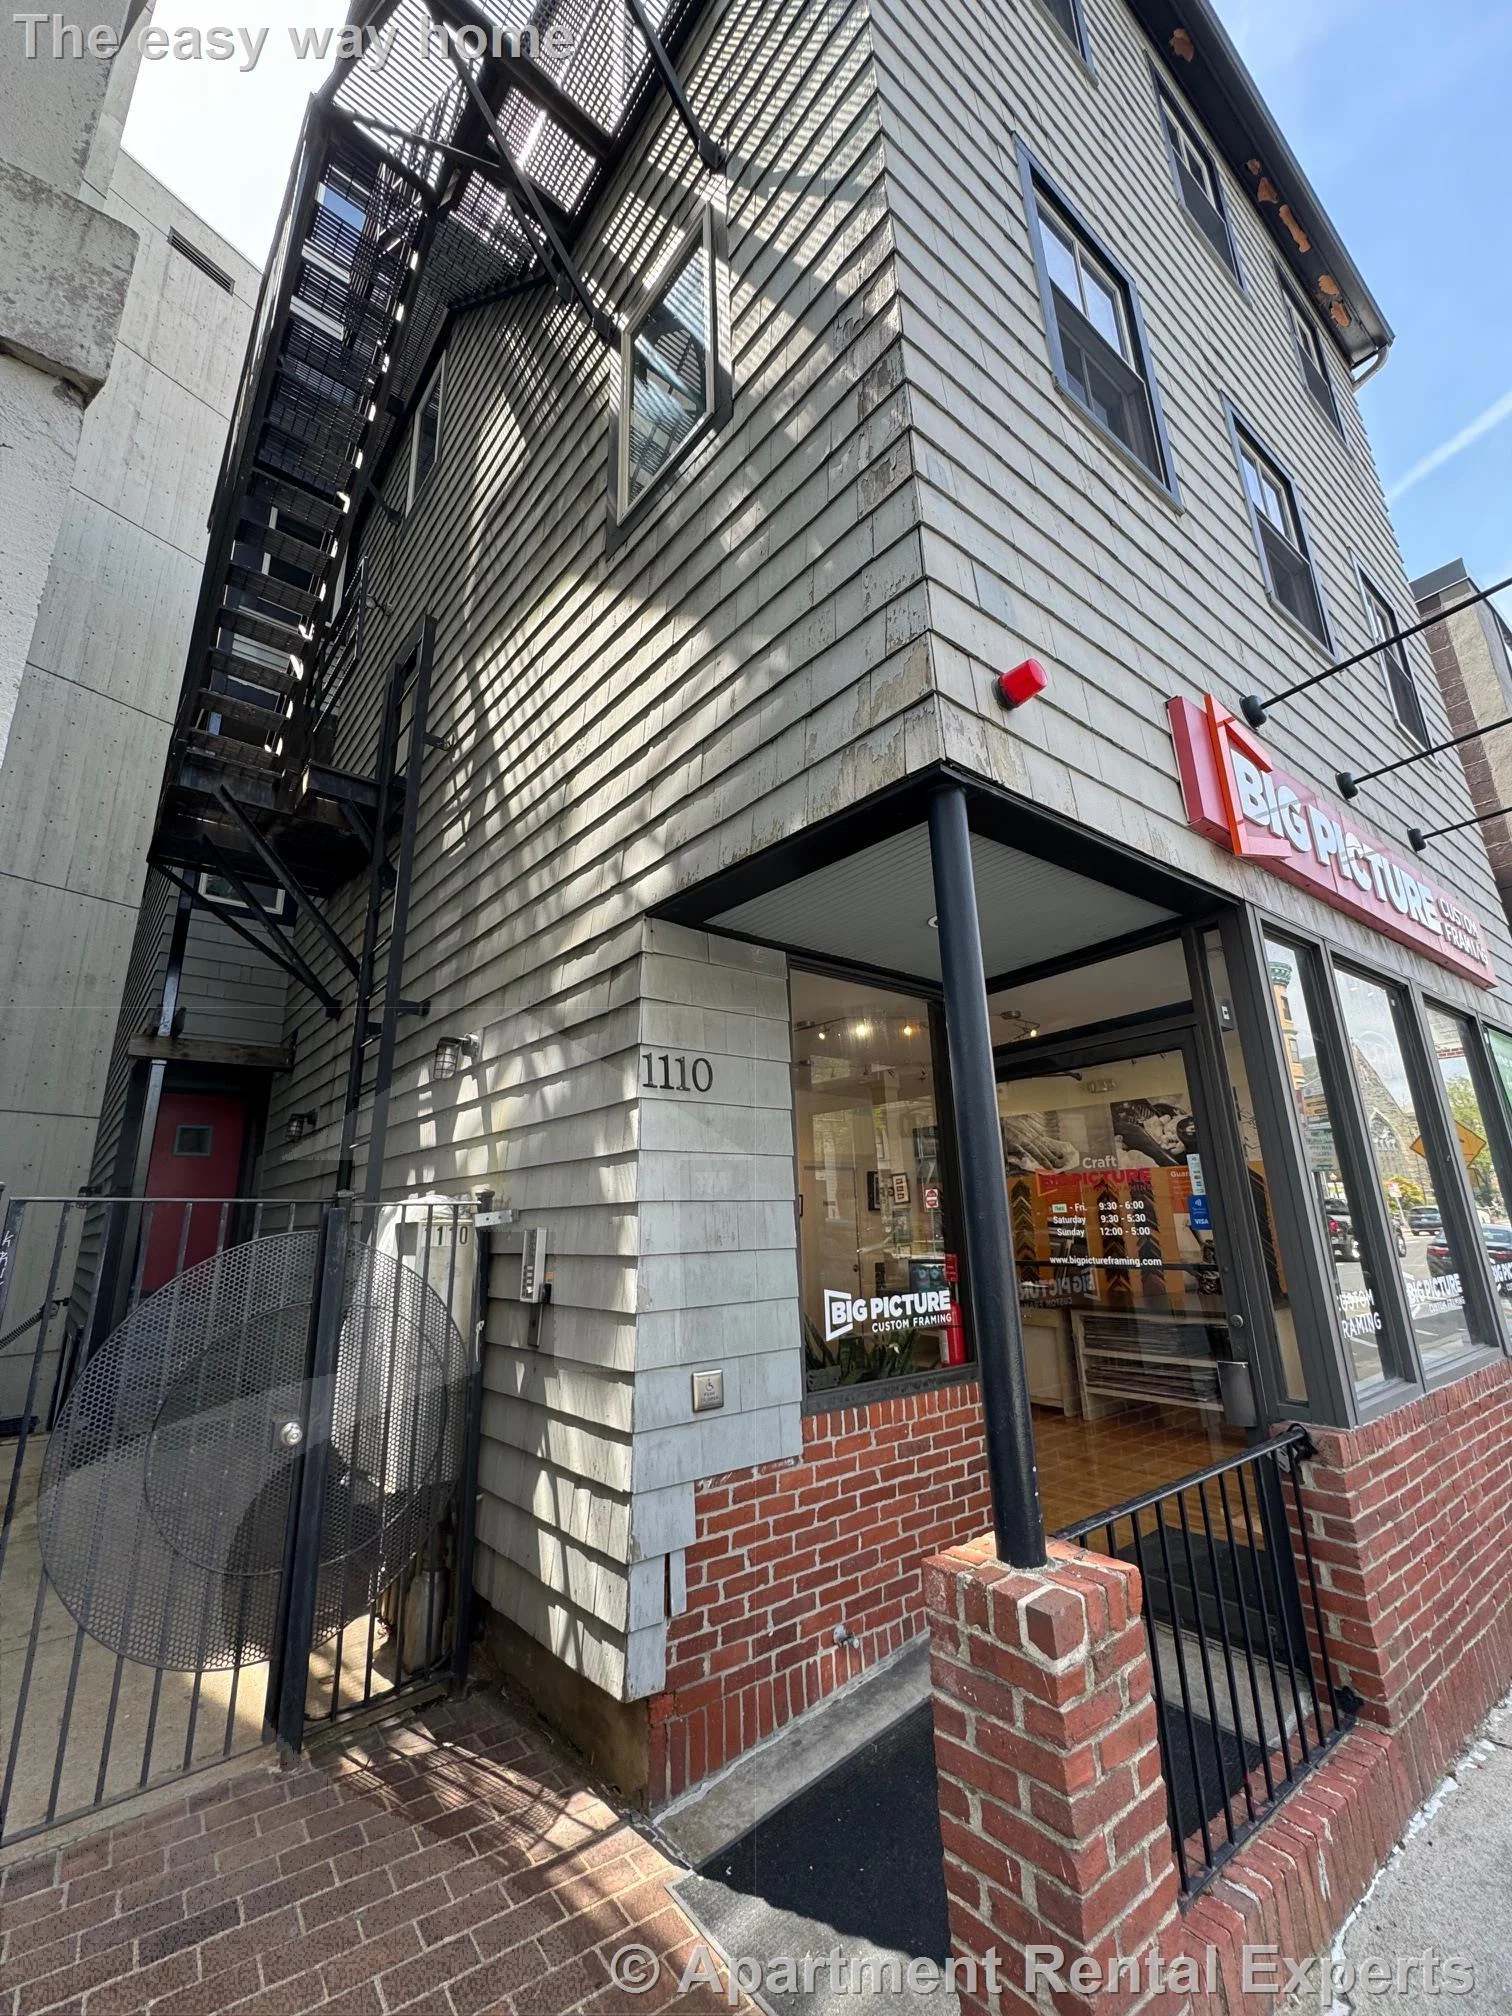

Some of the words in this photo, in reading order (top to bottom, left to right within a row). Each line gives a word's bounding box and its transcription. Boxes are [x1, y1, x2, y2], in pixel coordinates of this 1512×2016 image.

[1230, 748, 1312, 853] BIG
[1306, 803, 1443, 936] PICTURE
[1438, 897, 1478, 938] CUSTOM
[1442, 922, 1488, 965] FRAMING
[641, 1052, 713, 1092] 1110
[1082, 1155, 1117, 1169] Craft
[1074, 1168, 1152, 1185] PICTURE
[1074, 1203, 1087, 1212] Fri.
[1099, 1202, 1117, 1211] 9:30
[1125, 1200, 1144, 1210] 6:00
[1053, 1215, 1086, 1226] Saturday
[1100, 1214, 1119, 1223] 9:30
[1127, 1214, 1146, 1223] 5:30
[1057, 1228, 1085, 1238] Sunday
[1100, 1227, 1123, 1236] 12:00
[1131, 1226, 1150, 1236] 5:00
[1050, 1255, 1162, 1267] www.bigpictureframing.com
[1406, 1280, 1424, 1302] BIG
[1424, 1273, 1463, 1298] PICTURE
[831, 1299, 868, 1325] BIG
[870, 1290, 951, 1320] PICTURE
[872, 1318, 910, 1333] CUSTOM
[913, 1313, 952, 1327] FRAMING
[1341, 1312, 1382, 1339] RAMING
